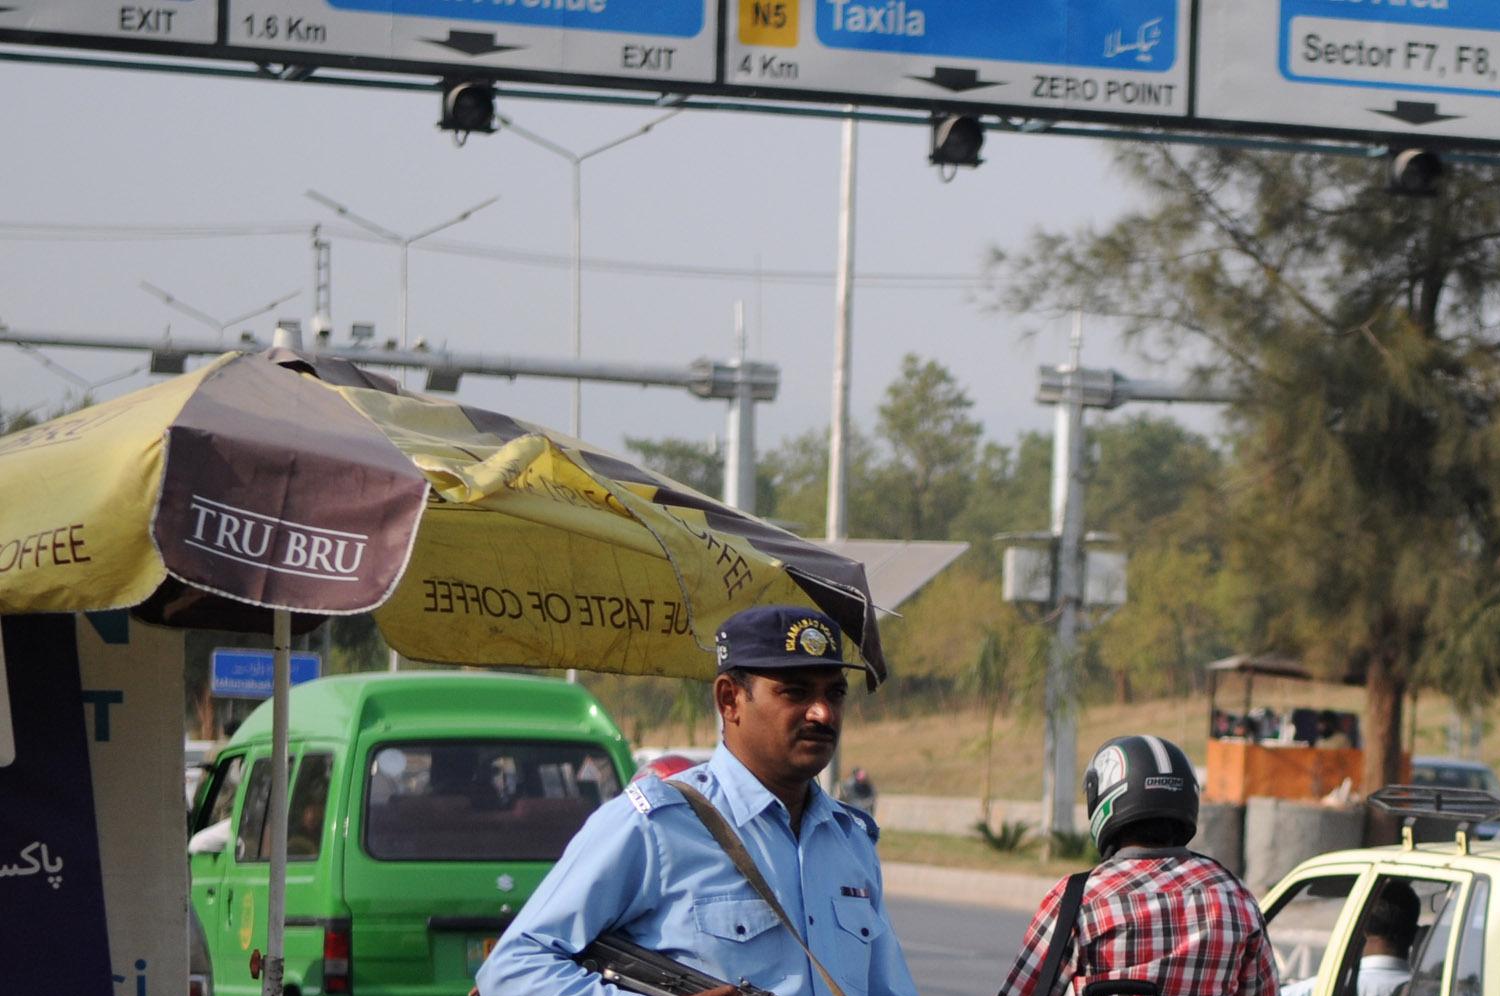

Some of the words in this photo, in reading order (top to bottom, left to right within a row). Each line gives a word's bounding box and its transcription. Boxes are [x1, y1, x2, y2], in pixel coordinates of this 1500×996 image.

[120, 7, 177, 33] EXIT
[245, 15, 277, 38] 1.6
[287, 18, 327, 43] Km
[752, 0, 787, 29] N5
[826, 0, 926, 37] Taxila
[622, 45, 677, 71] EXIT
[738, 55, 752, 75] 4
[760, 56, 799, 80] Km
[1303, 33, 1397, 68] Sector
[1404, 42, 1447, 78] F7,
[1456, 46, 1498, 81] F8,
[1031, 75, 1099, 100] ZERO
[1106, 79, 1176, 106] POINT
[0, 523, 92, 573] OFFEE
[190, 503, 275, 559] TRU
[283, 530, 367, 575] BRU
